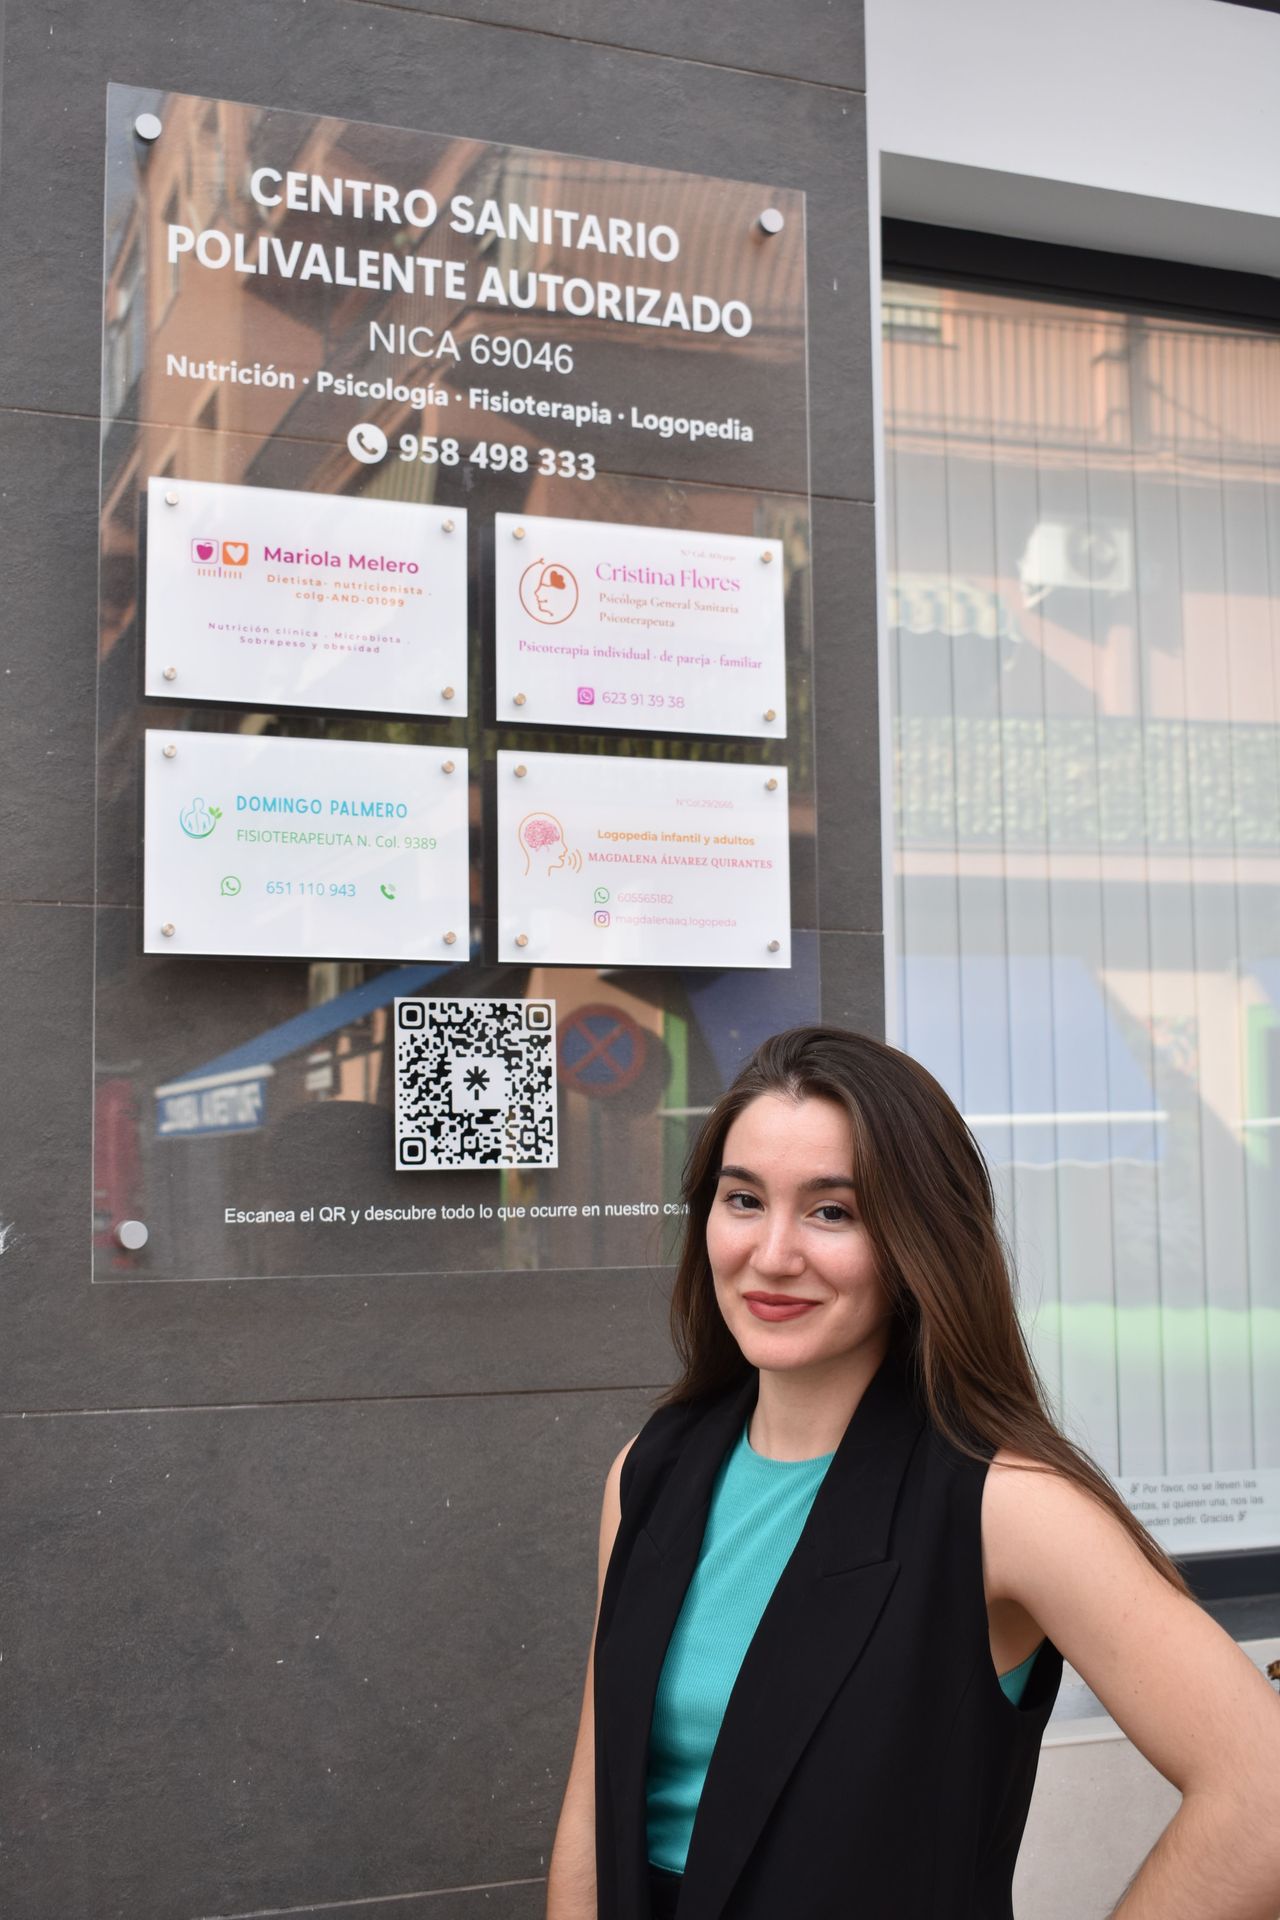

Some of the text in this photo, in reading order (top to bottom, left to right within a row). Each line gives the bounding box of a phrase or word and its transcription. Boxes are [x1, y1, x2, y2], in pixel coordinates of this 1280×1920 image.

[250, 167, 680, 262] CENTRO SANITARIO
[167, 224, 752, 338] POLIVALENTE AUTORIZADO
[369, 321, 574, 375] NICA 69046
[166, 354, 754, 442] Nutrición Psicología Fisioterapia Logopedia
[399, 434, 596, 481] 958 498 333
[263, 546, 419, 574] Mariola Melero
[596, 562, 741, 592] Cristina Flores
[334, 581, 423, 596] nutricionista
[599, 592, 739, 614] Psicóloga General Sanitaria
[599, 612, 675, 629] Psicoterapeuta
[208, 622, 270, 634] Nutrición
[335, 632, 400, 643] Microbiota
[240, 636, 306, 648] Sobrepeso
[324, 643, 380, 653] obesidad
[519, 640, 762, 669] Psicoterapia individual de pareja familiar
[602, 691, 685, 709] 623 91 39 38
[236, 795, 408, 818] DOMINGO PALMERO
[237, 829, 437, 850] FISIOTERAPEUTA N. Col. 9389
[598, 830, 755, 846] Logopedia infantil y adultos
[588, 852, 773, 869] MAGDALENA ÁLVAREZ QUIRANTES
[266, 881, 356, 897] 651 110 943
[225, 1208, 295, 1223] Escanea
[300, 1207, 314, 1222] el
[319, 1206, 346, 1223] QR
[351, 1209, 361, 1225] y
[364, 1205, 436, 1221] descubre
[441, 1204, 475, 1219] todo
[479, 1204, 493, 1219] lo
[497, 1206, 525, 1221] que
[530, 1204, 577, 1218] ocurre
[582, 1204, 600, 1217] en
[605, 1202, 659, 1216] nuestro
[1142, 1483, 1157, 1493] Por
[1187, 1482, 1198, 1491] no
[1201, 1483, 1212, 1491] se
[1200, 1512, 1234, 1523] Gracias
